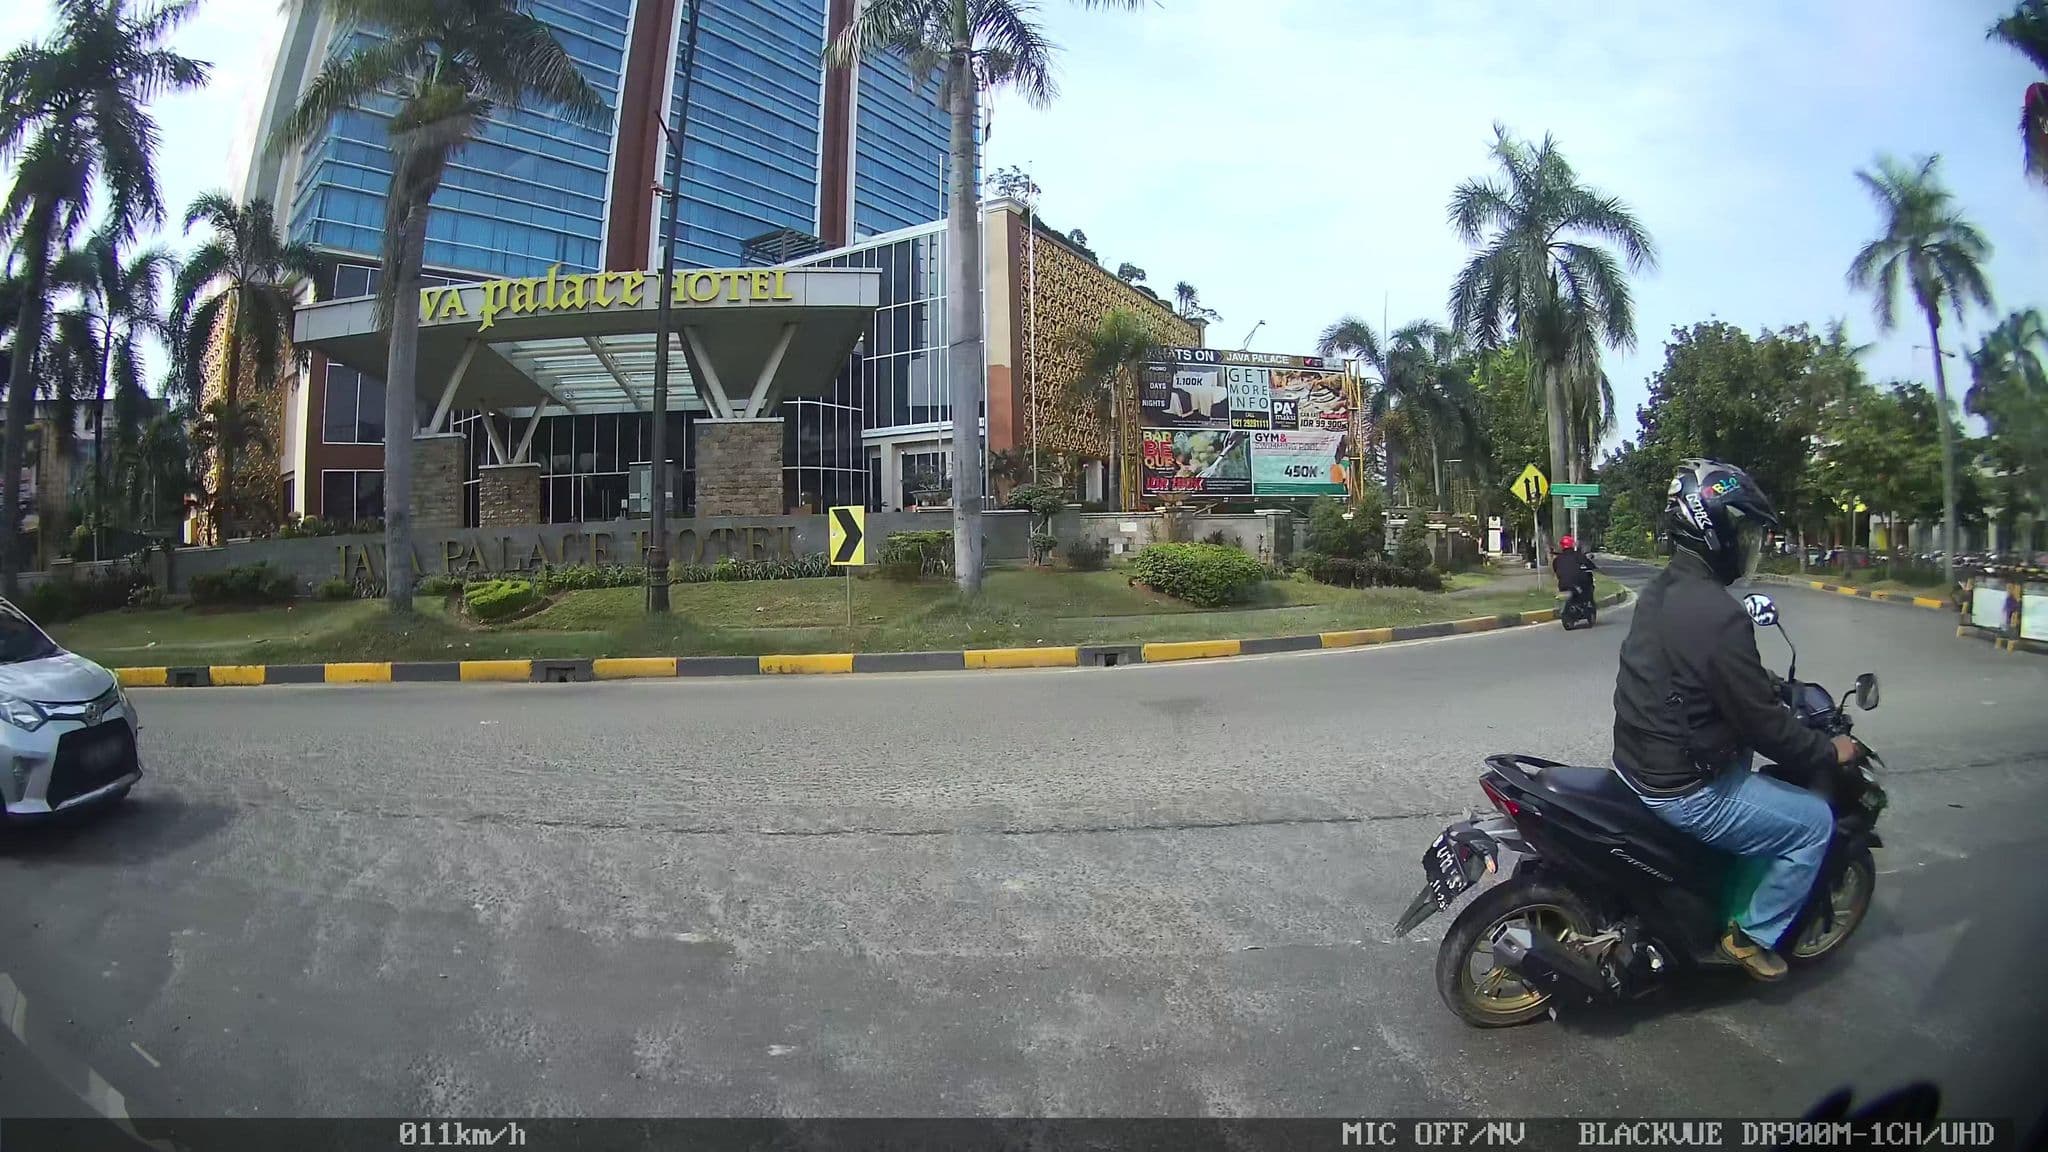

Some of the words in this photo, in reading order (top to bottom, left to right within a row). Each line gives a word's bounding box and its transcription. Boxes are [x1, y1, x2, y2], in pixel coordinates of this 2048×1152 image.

[420, 287, 468, 321] VA
[477, 262, 646, 333] palace
[1194, 350, 1215, 362] ON
[1226, 352, 1250, 363] JAVA
[1251, 354, 1290, 365] PALACE
[1175, 377, 1203, 386] 1.100K
[1228, 367, 1267, 383] GET
[1148, 382, 1167, 390] DAYS
[1229, 383, 1269, 397] MORE
[1141, 399, 1167, 408] NIGHTS
[1230, 397, 1269, 410] INFO
[1143, 431, 1172, 442] BAR
[1144, 441, 1173, 457] BE
[1284, 465, 1318, 478] 450K
[440, 532, 615, 573] PALACE
